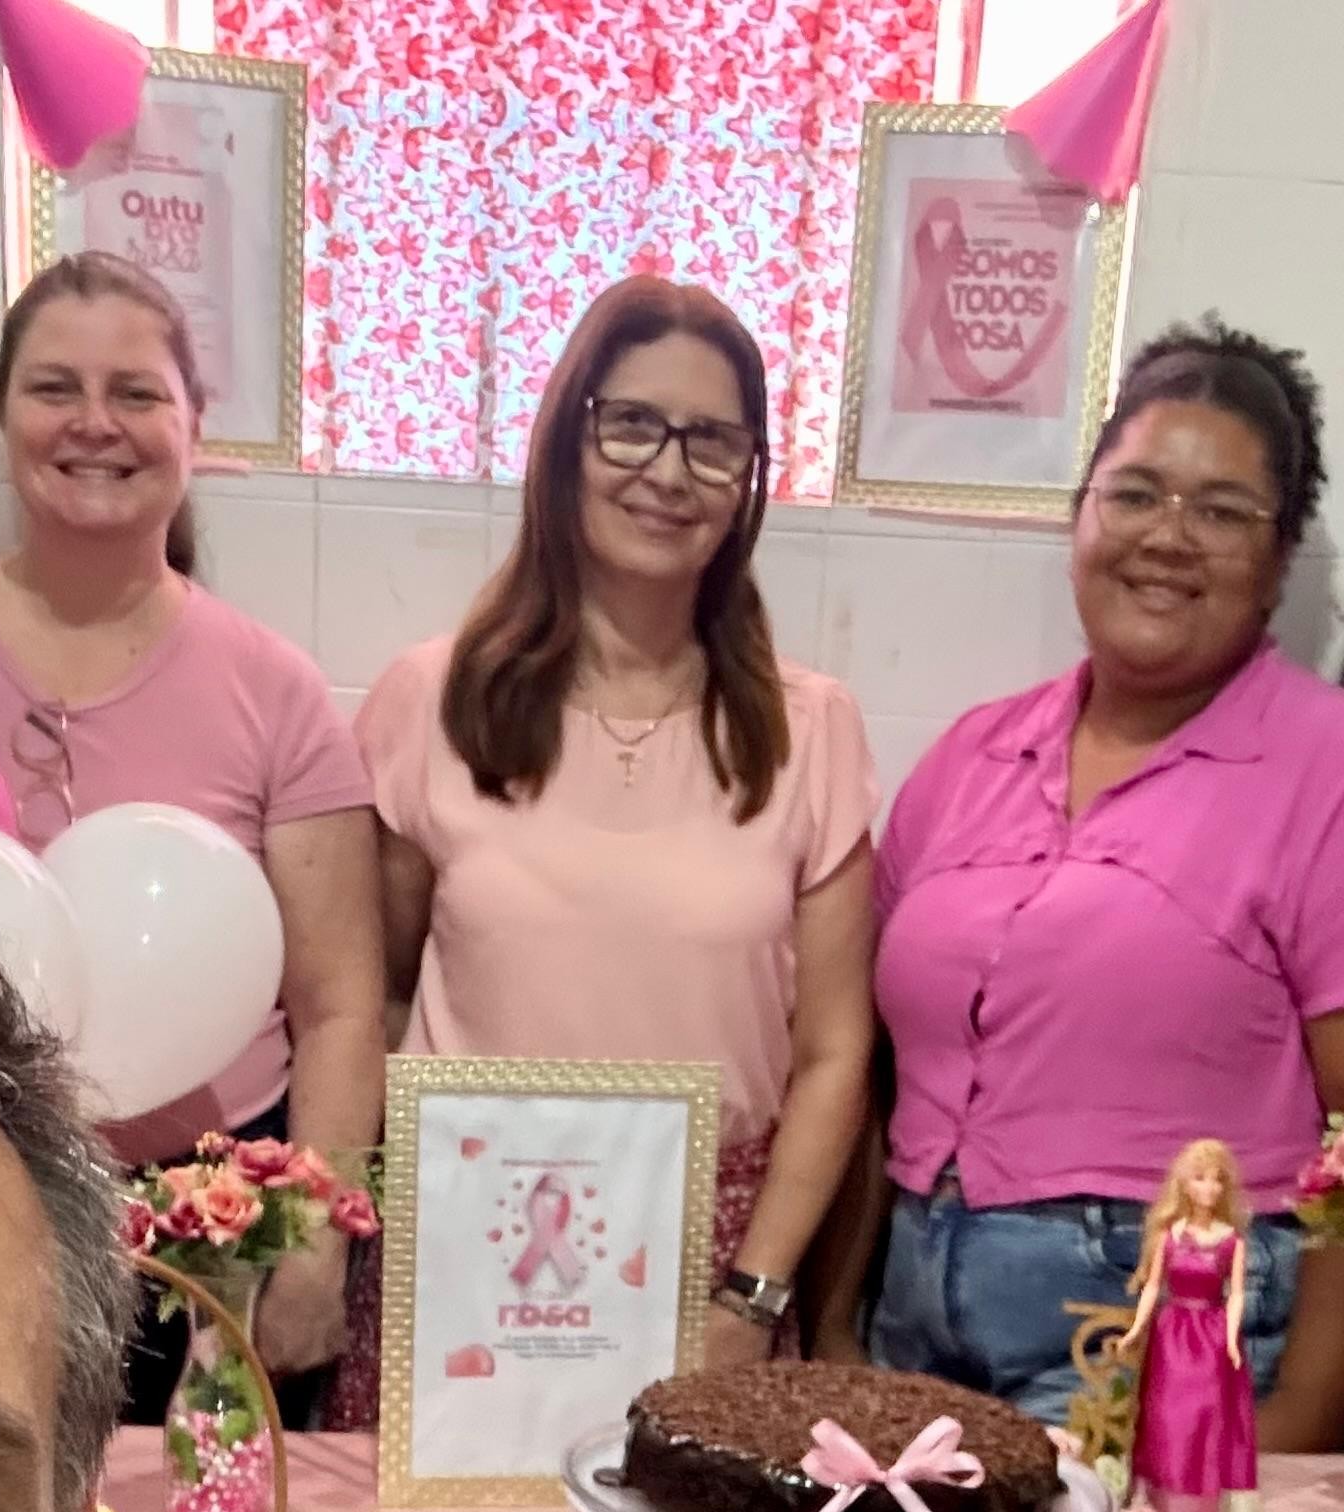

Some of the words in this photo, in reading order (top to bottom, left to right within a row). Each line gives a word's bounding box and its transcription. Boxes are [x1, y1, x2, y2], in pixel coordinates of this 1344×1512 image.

[121, 190, 204, 225] Outu
[954, 249, 1058, 281] SOMOS
[952, 283, 1048, 317] TODOS
